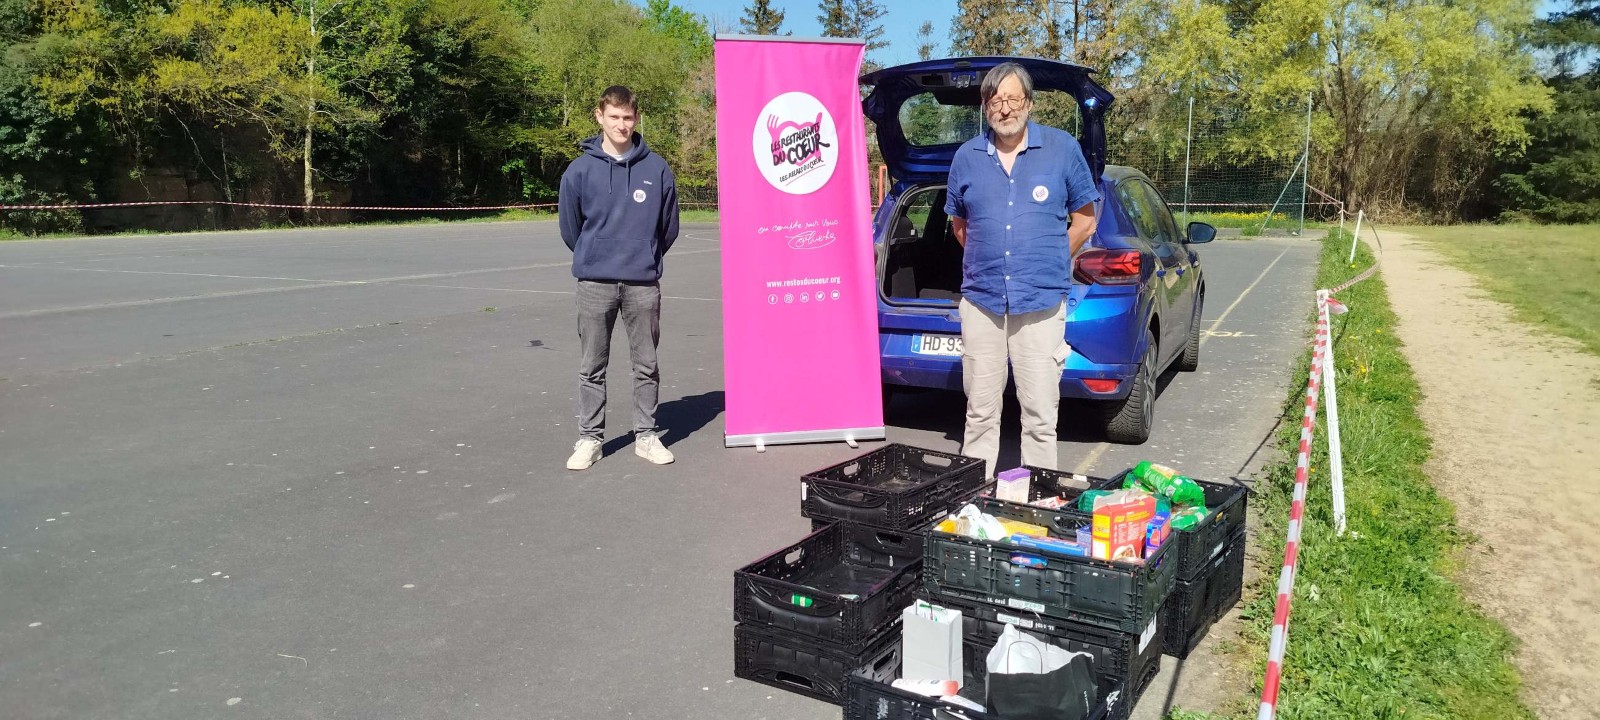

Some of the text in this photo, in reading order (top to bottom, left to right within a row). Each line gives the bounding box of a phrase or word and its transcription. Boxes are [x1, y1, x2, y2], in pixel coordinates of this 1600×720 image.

[770, 122, 820, 153] LES RESTAURANTS
[773, 151, 786, 166] DU
[766, 276, 841, 288] www.restosducoeur.org
